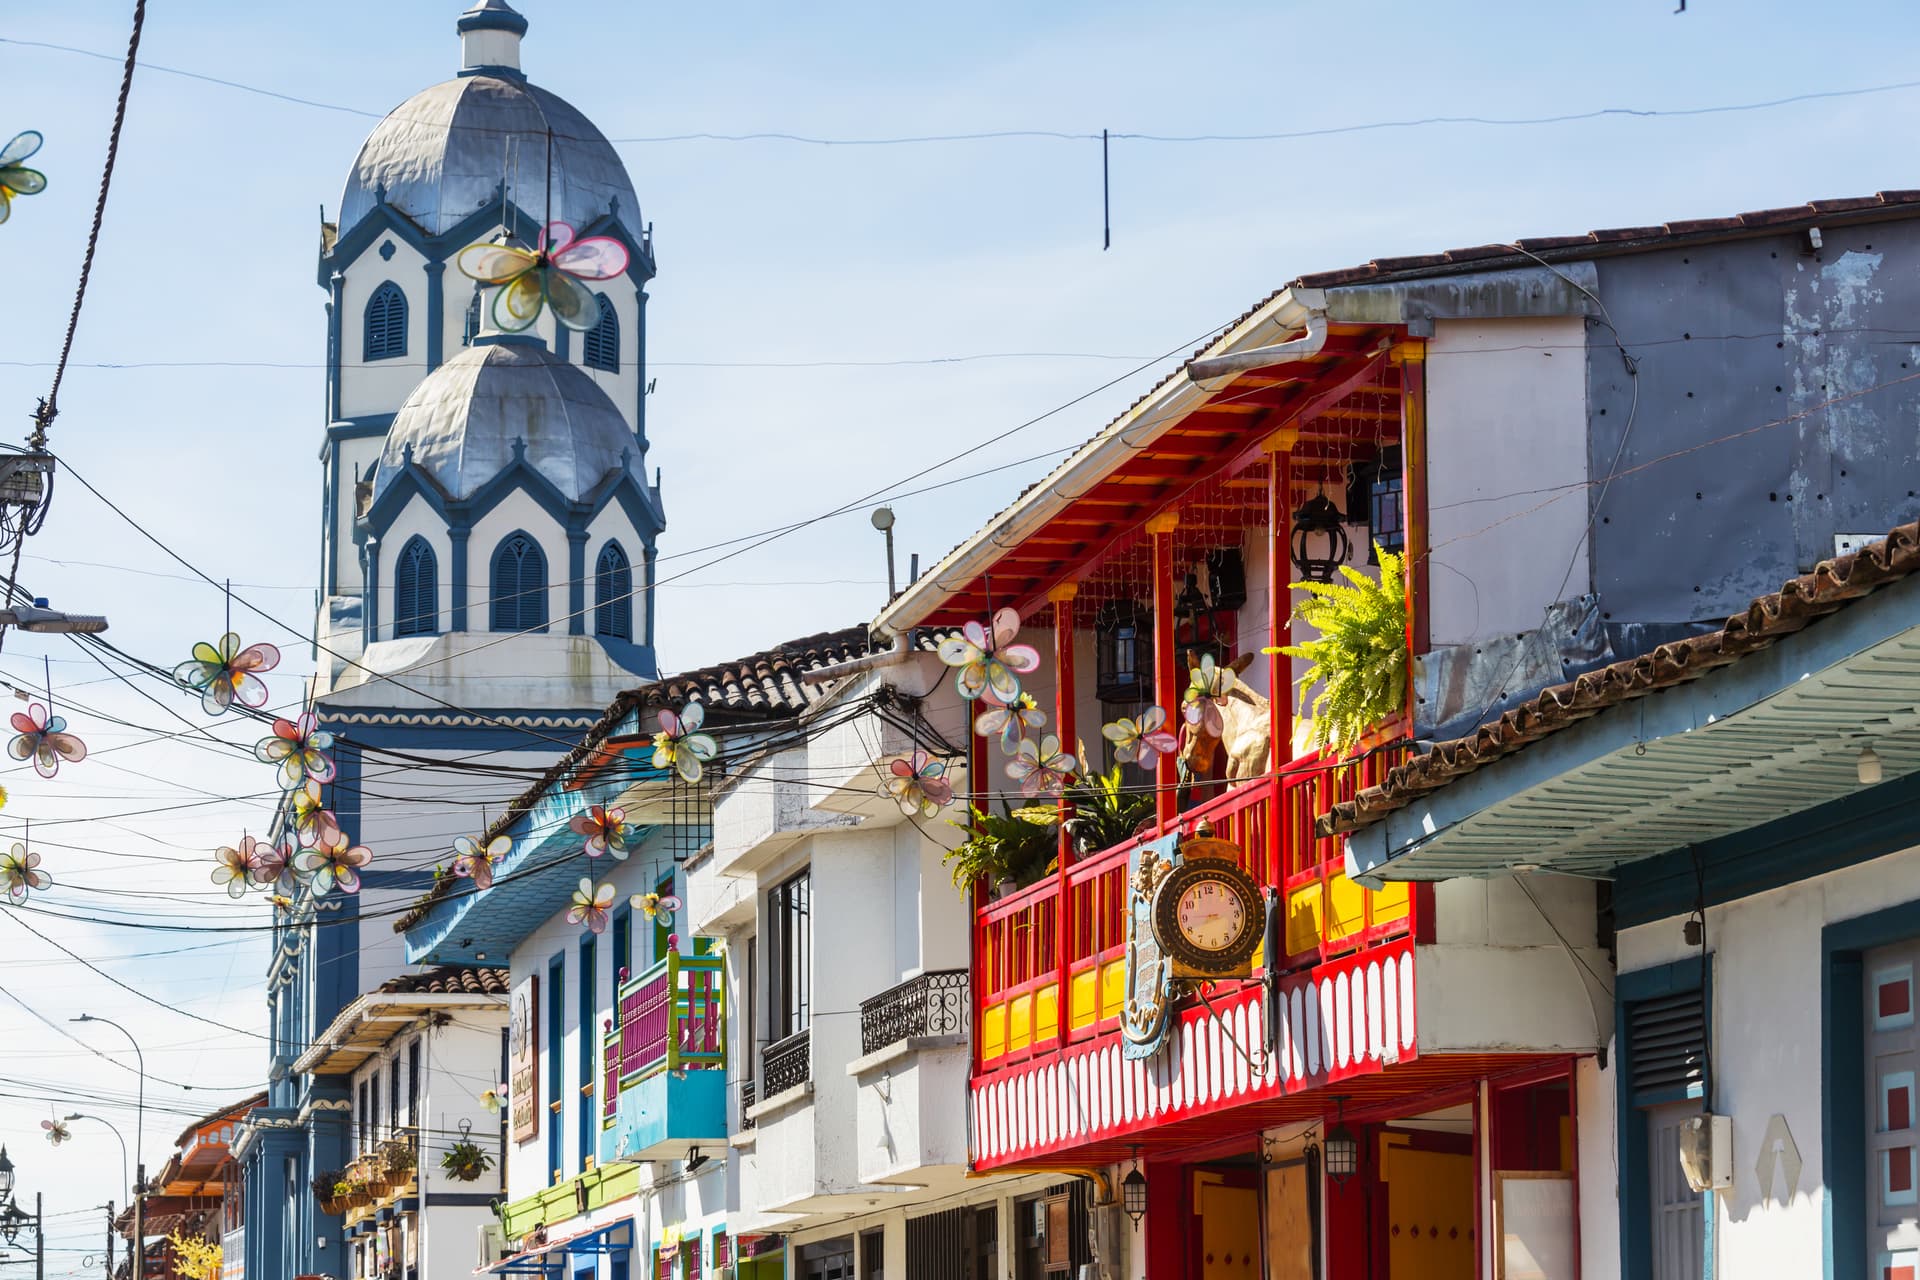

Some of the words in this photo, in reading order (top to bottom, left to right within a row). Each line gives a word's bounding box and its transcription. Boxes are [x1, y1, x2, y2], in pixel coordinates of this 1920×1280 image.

[1193, 889, 1202, 899] 11
[1203, 884, 1213, 895] 12
[1219, 887, 1224, 897] 1
[1185, 900, 1194, 910] 10
[1228, 897, 1235, 906] 2
[1182, 914, 1188, 923] 9
[1233, 910, 1240, 919] 3
[1187, 926, 1193, 934] 8
[1232, 922, 1238, 931] 4
[1198, 934, 1203, 943] 7
[1223, 933, 1230, 942] 5
[1211, 938, 1217, 947] 6
